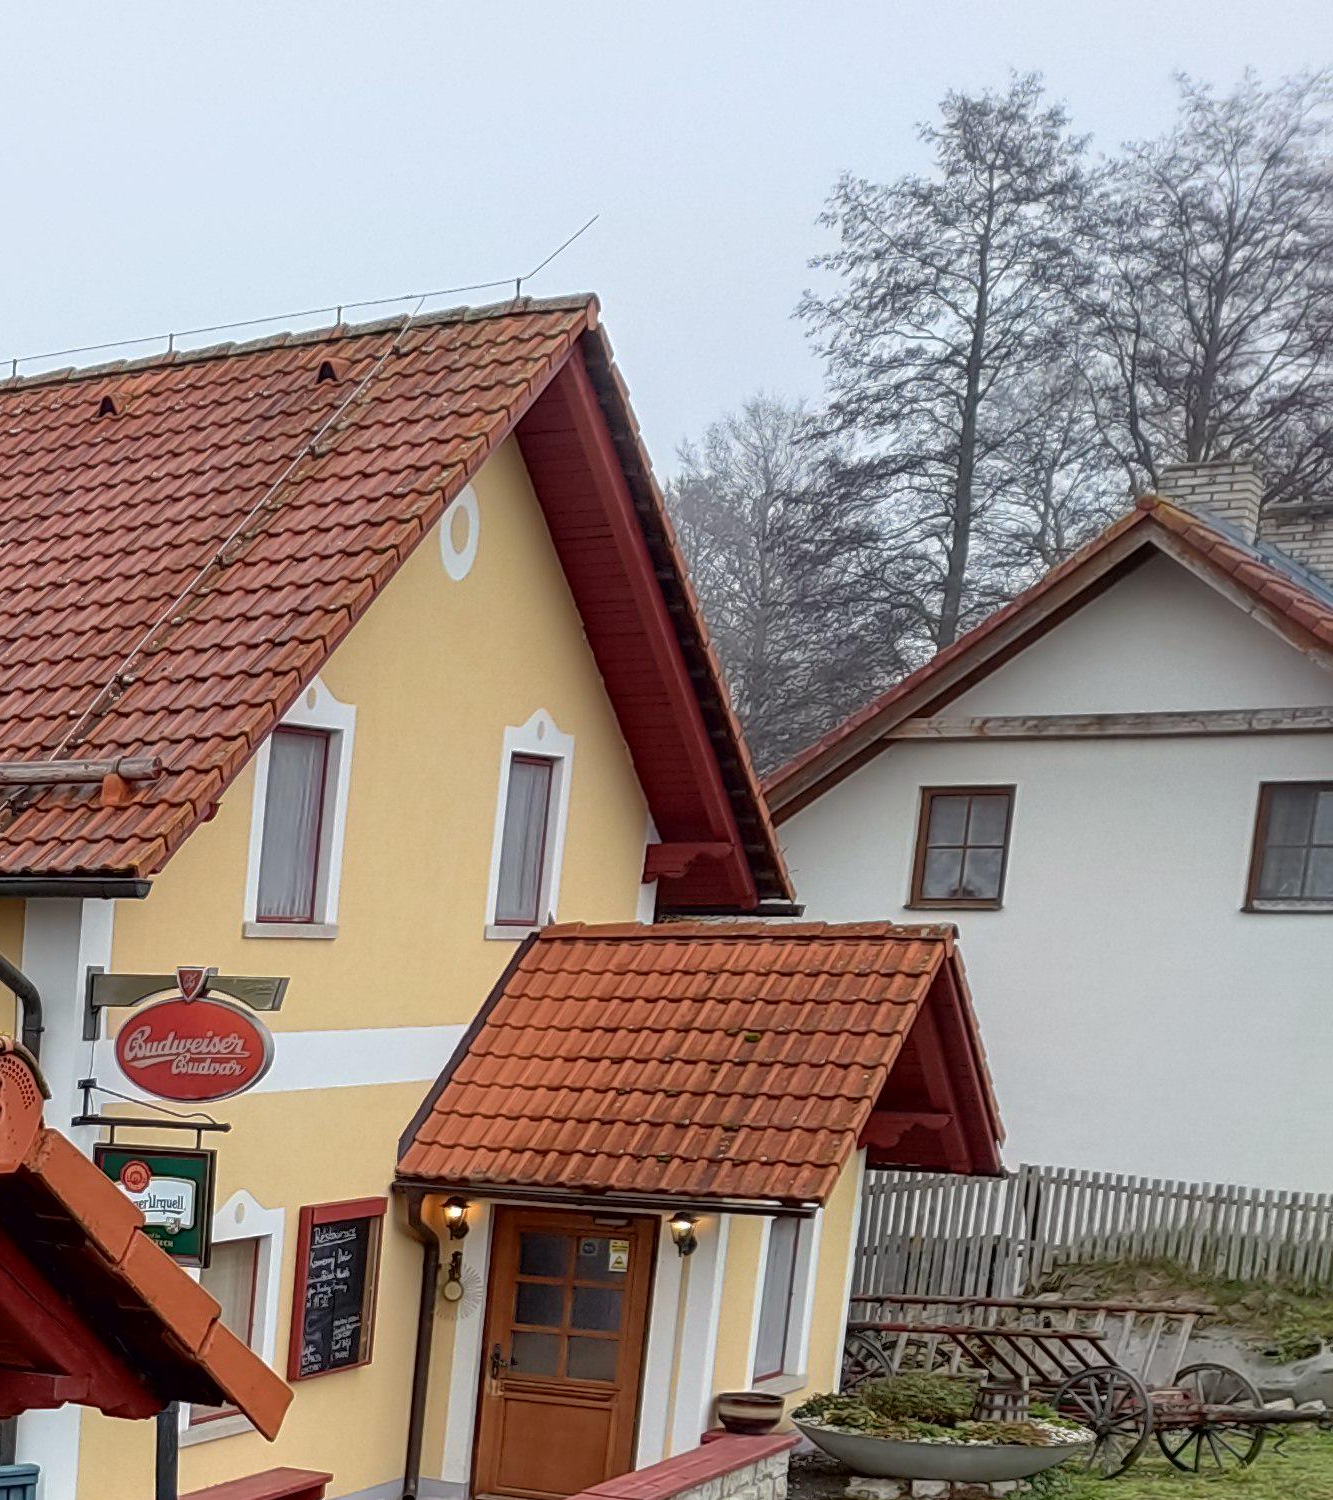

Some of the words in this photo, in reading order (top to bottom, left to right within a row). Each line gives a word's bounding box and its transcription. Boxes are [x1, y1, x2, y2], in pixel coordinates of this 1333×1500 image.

[124, 1026, 250, 1062] Budweiser
[171, 1053, 246, 1076] Budvar
[148, 1193, 184, 1214] Urquell
